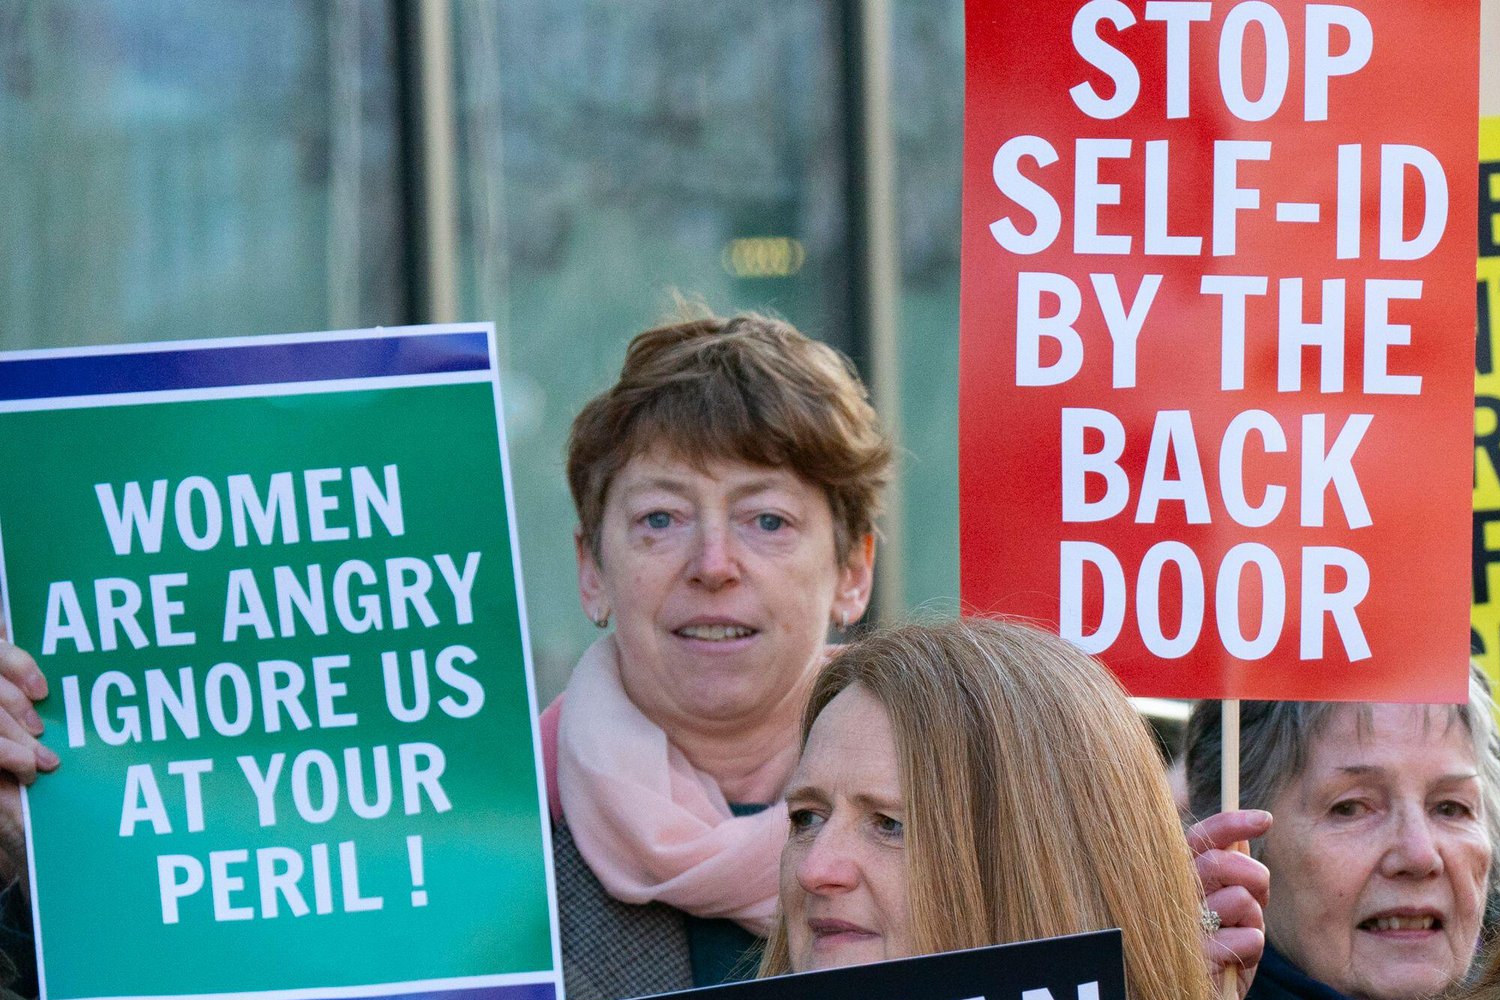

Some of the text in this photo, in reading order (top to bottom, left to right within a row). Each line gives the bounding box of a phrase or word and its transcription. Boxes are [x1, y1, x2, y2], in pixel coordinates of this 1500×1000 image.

[1069, 0, 1374, 122] STOP
[988, 135, 1450, 262] SELF-ID
[1015, 272, 1164, 390] BY
[1200, 275, 1425, 397] THE
[94, 463, 406, 556] WOMEN
[1060, 407, 1375, 530] BACK
[41, 551, 482, 656] ARE ANGRY
[1058, 540, 1372, 663] DOOR
[61, 644, 486, 749] IGNORE US
[118, 741, 453, 838] AT YOUR
[156, 838, 384, 925] PERIL
